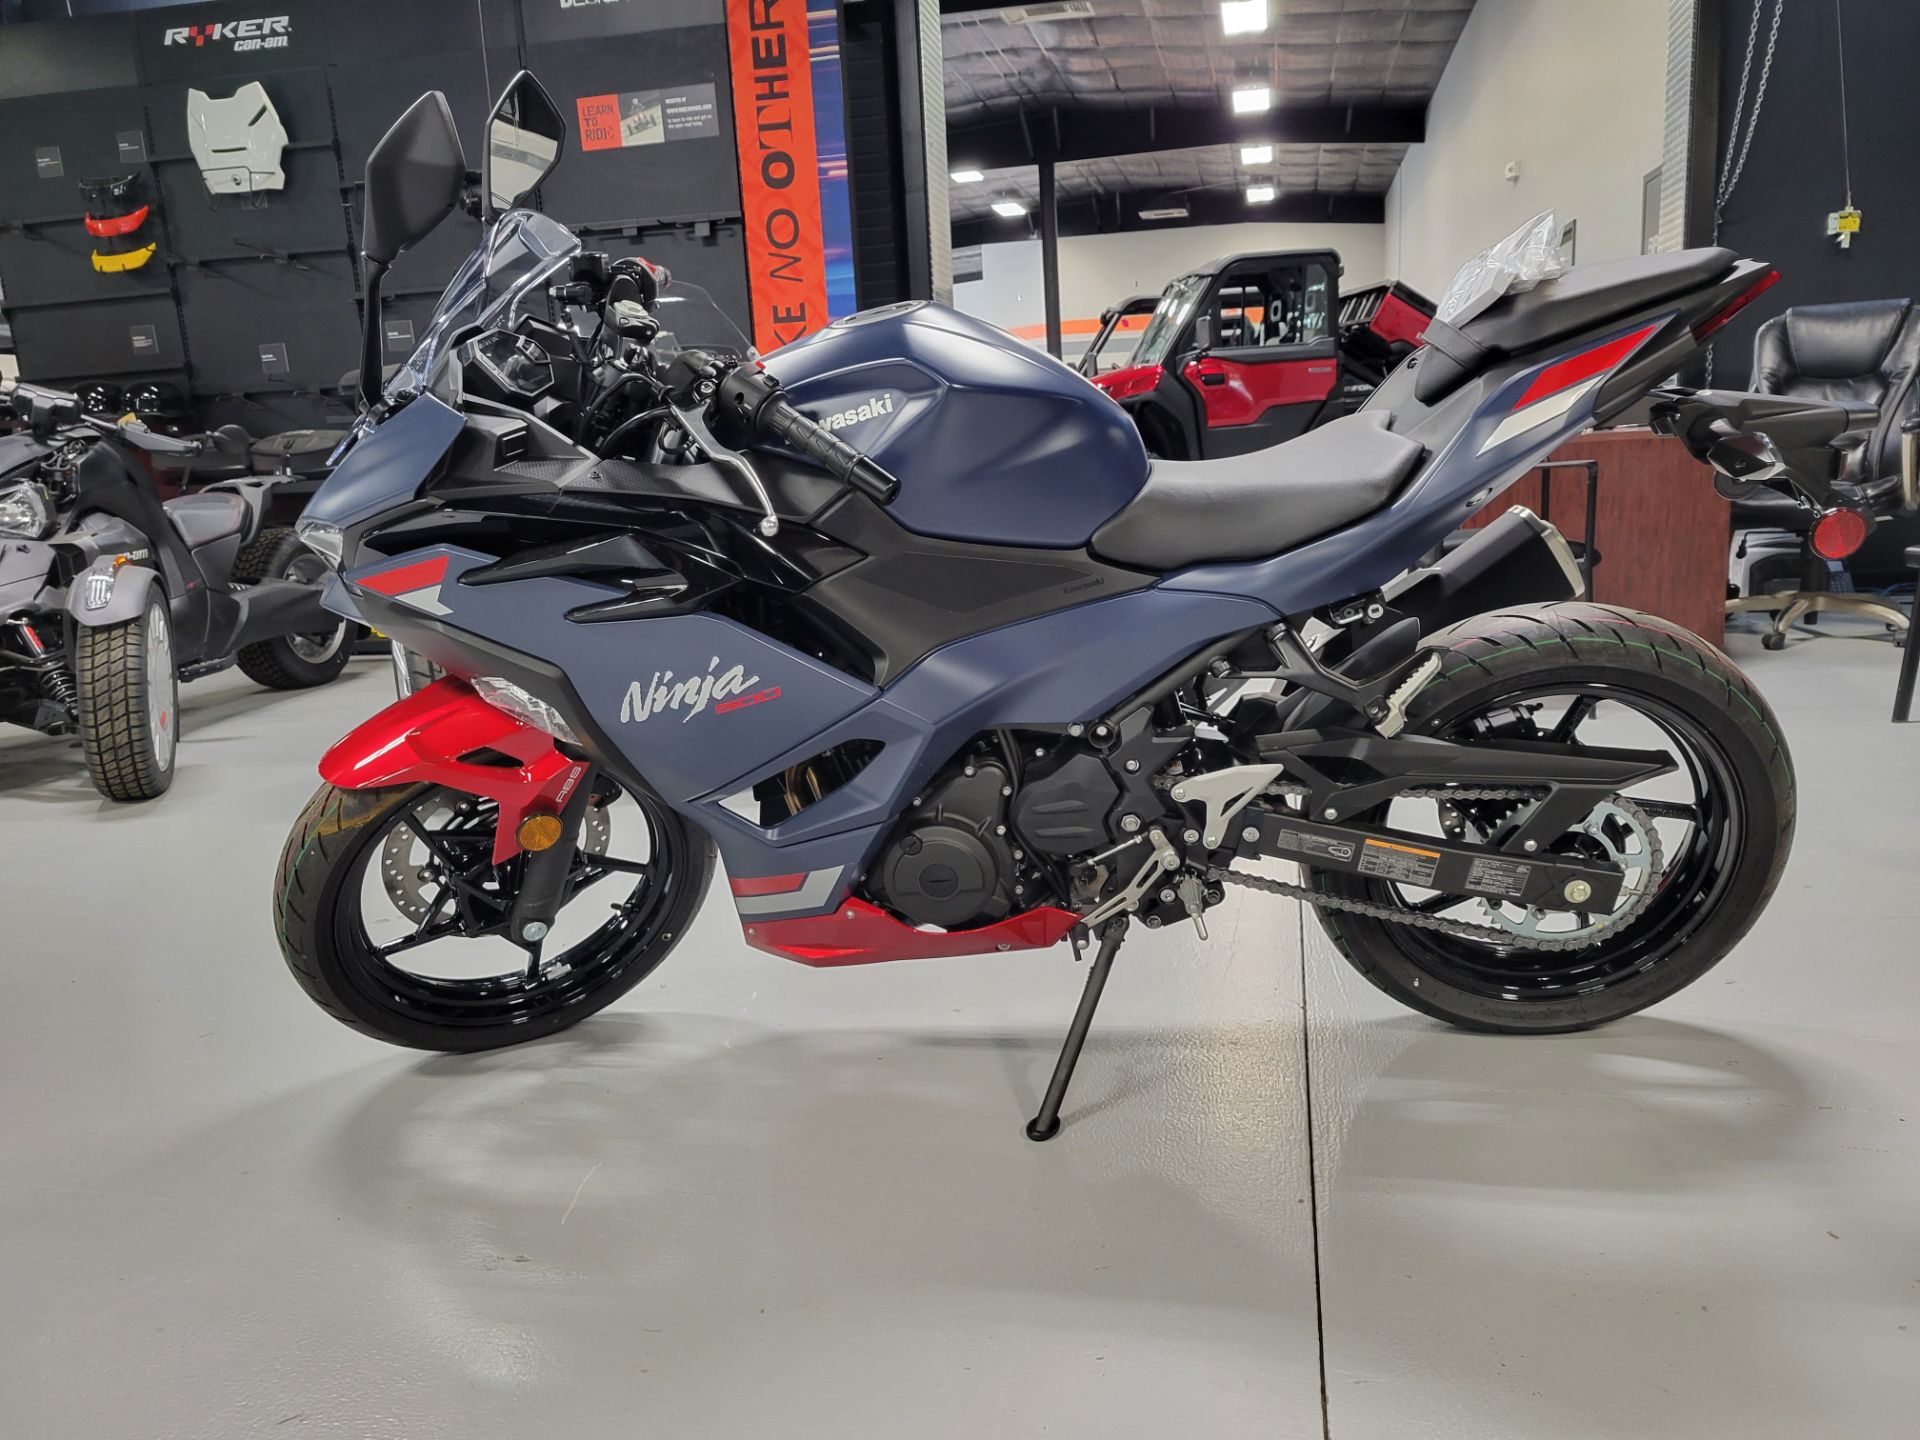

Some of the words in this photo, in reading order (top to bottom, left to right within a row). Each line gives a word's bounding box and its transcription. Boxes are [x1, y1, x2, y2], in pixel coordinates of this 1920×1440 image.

[163, 15, 290, 47] RYKER
[233, 35, 289, 52] can-am
[582, 103, 614, 117] LEARN
[749, 0, 796, 191] OTHER
[584, 116, 599, 128] TO
[767, 207, 804, 284] NO
[818, 392, 893, 432] wasaki
[620, 655, 760, 724] Ninja
[714, 686, 782, 715] 500
[555, 765, 582, 803] ABS
